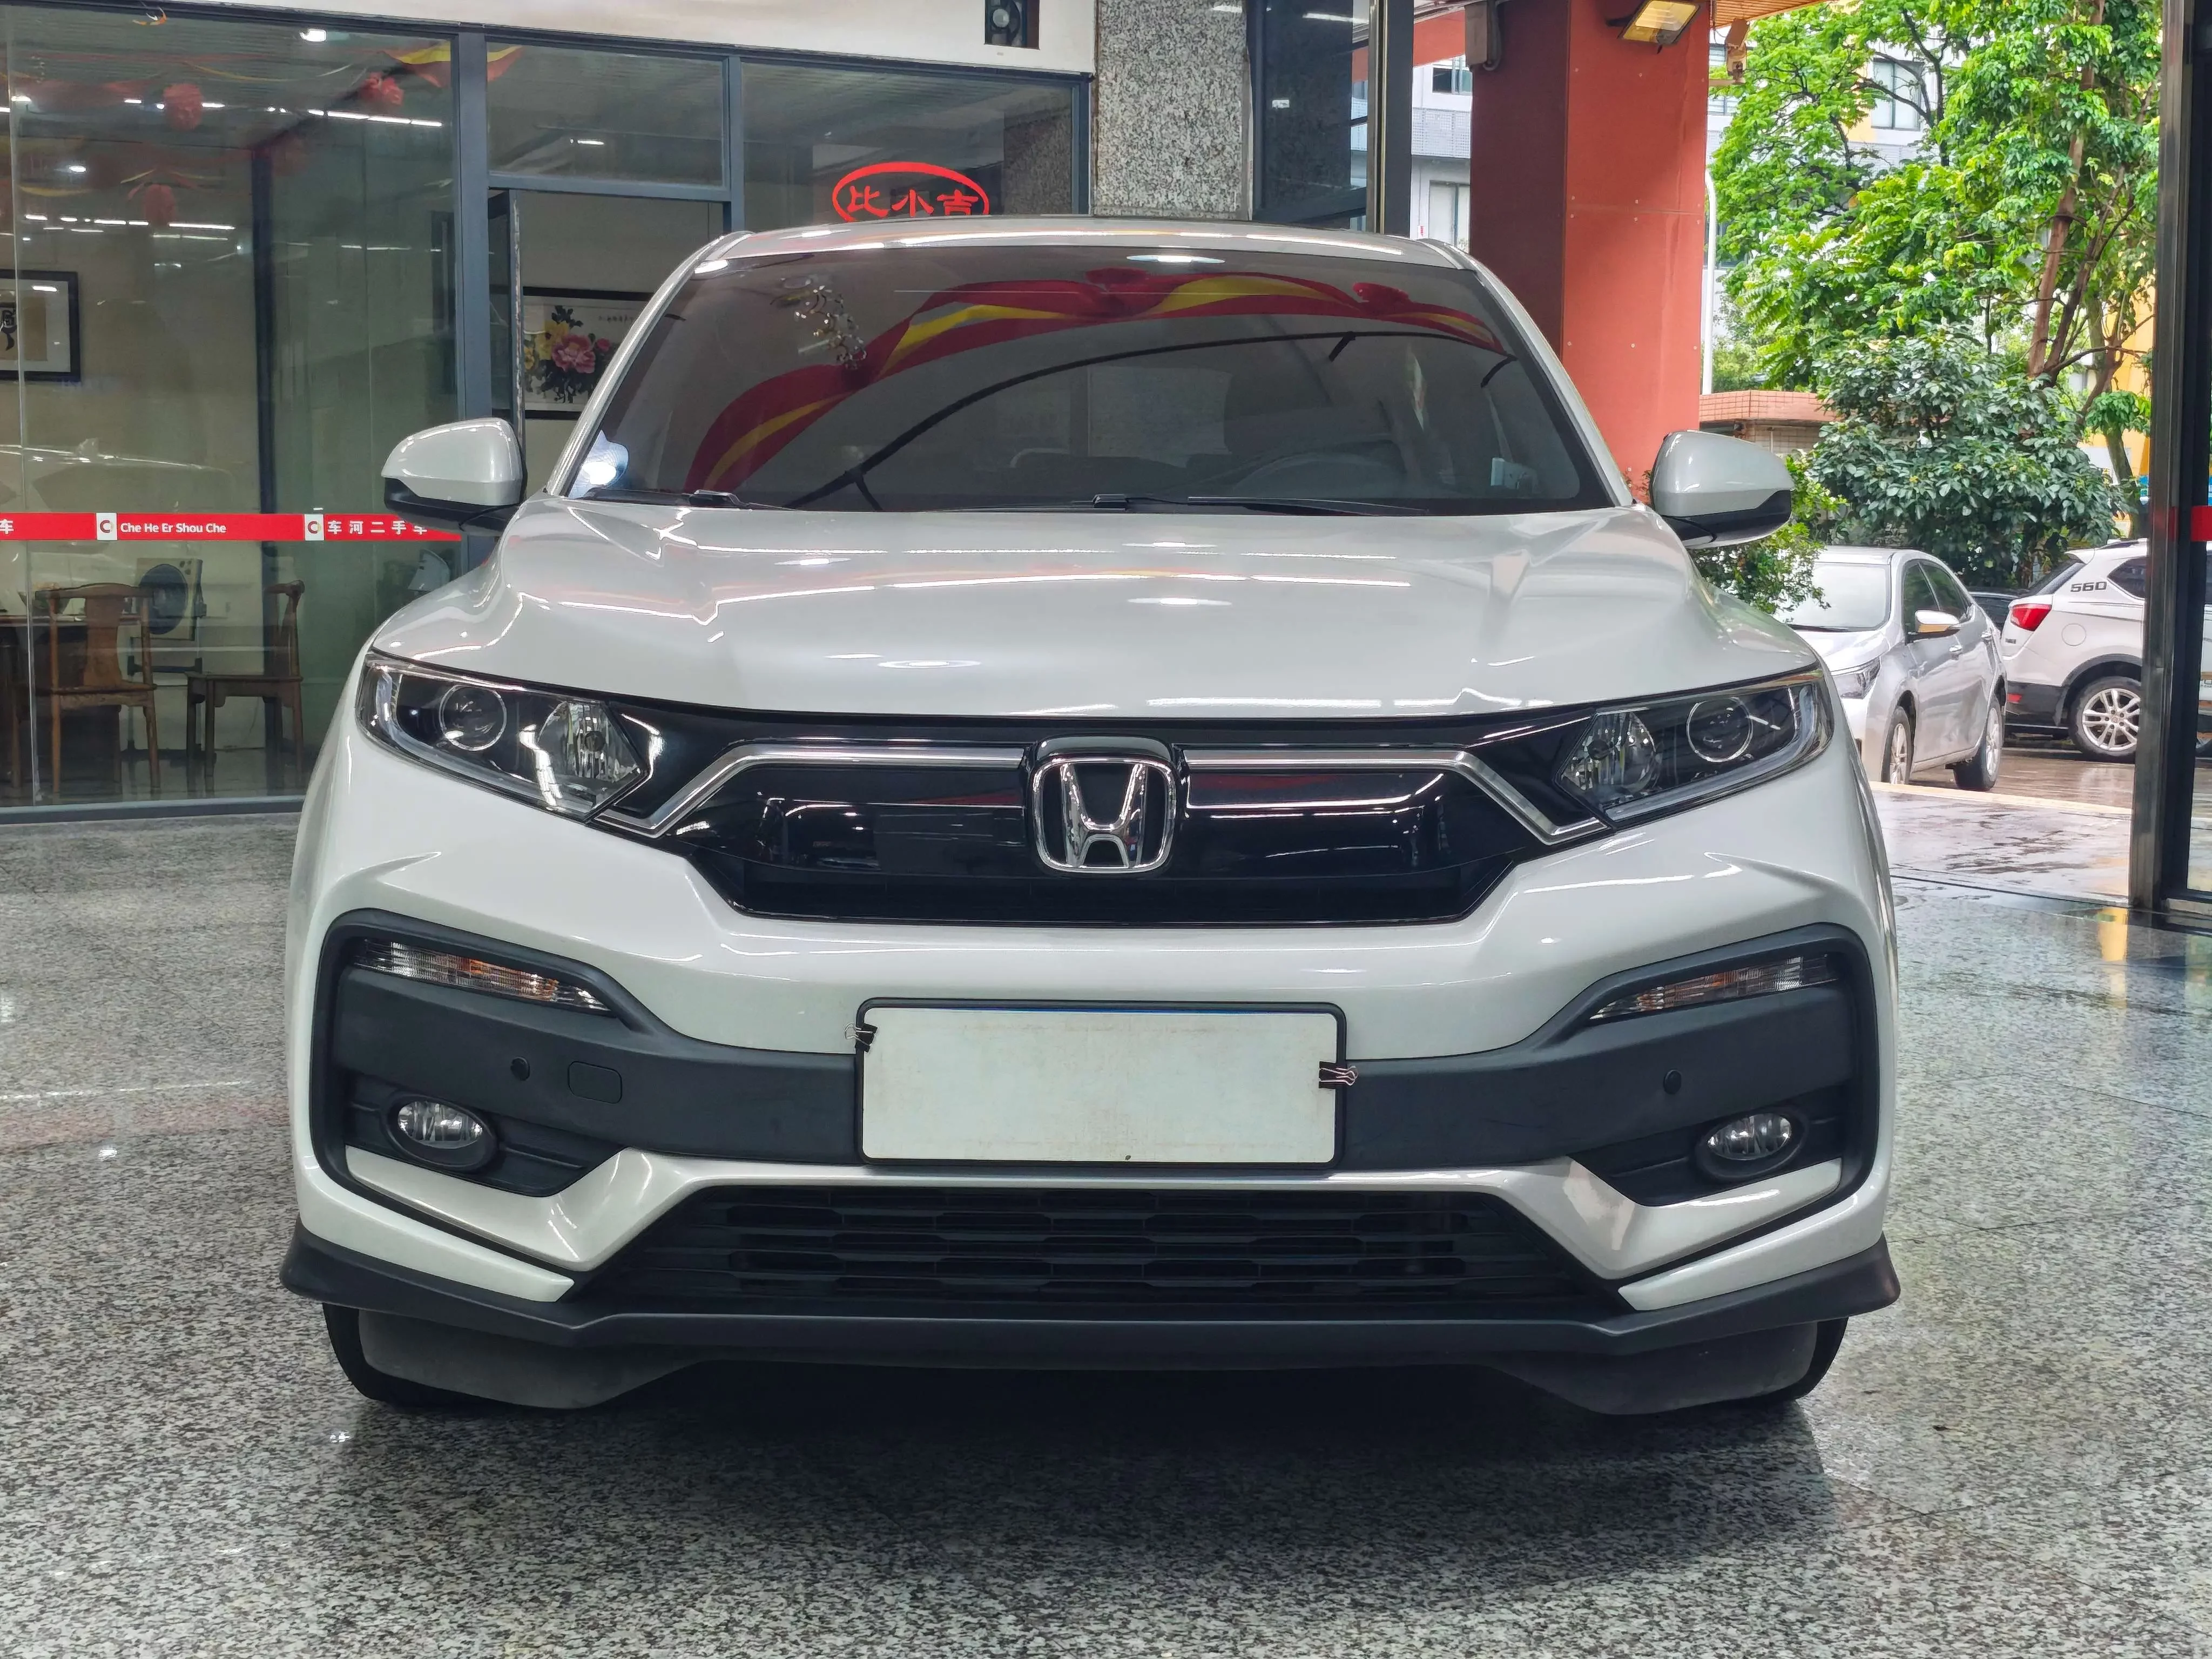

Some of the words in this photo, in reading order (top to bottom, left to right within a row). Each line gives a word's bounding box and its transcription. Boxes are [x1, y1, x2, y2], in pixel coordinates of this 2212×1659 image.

[120, 523, 141, 533] Che
[144, 523, 159, 533] He
[161, 523, 173, 533] Er
[176, 522, 203, 533] Shou
[205, 523, 226, 533] Che
[2070, 581, 2107, 592] 560
